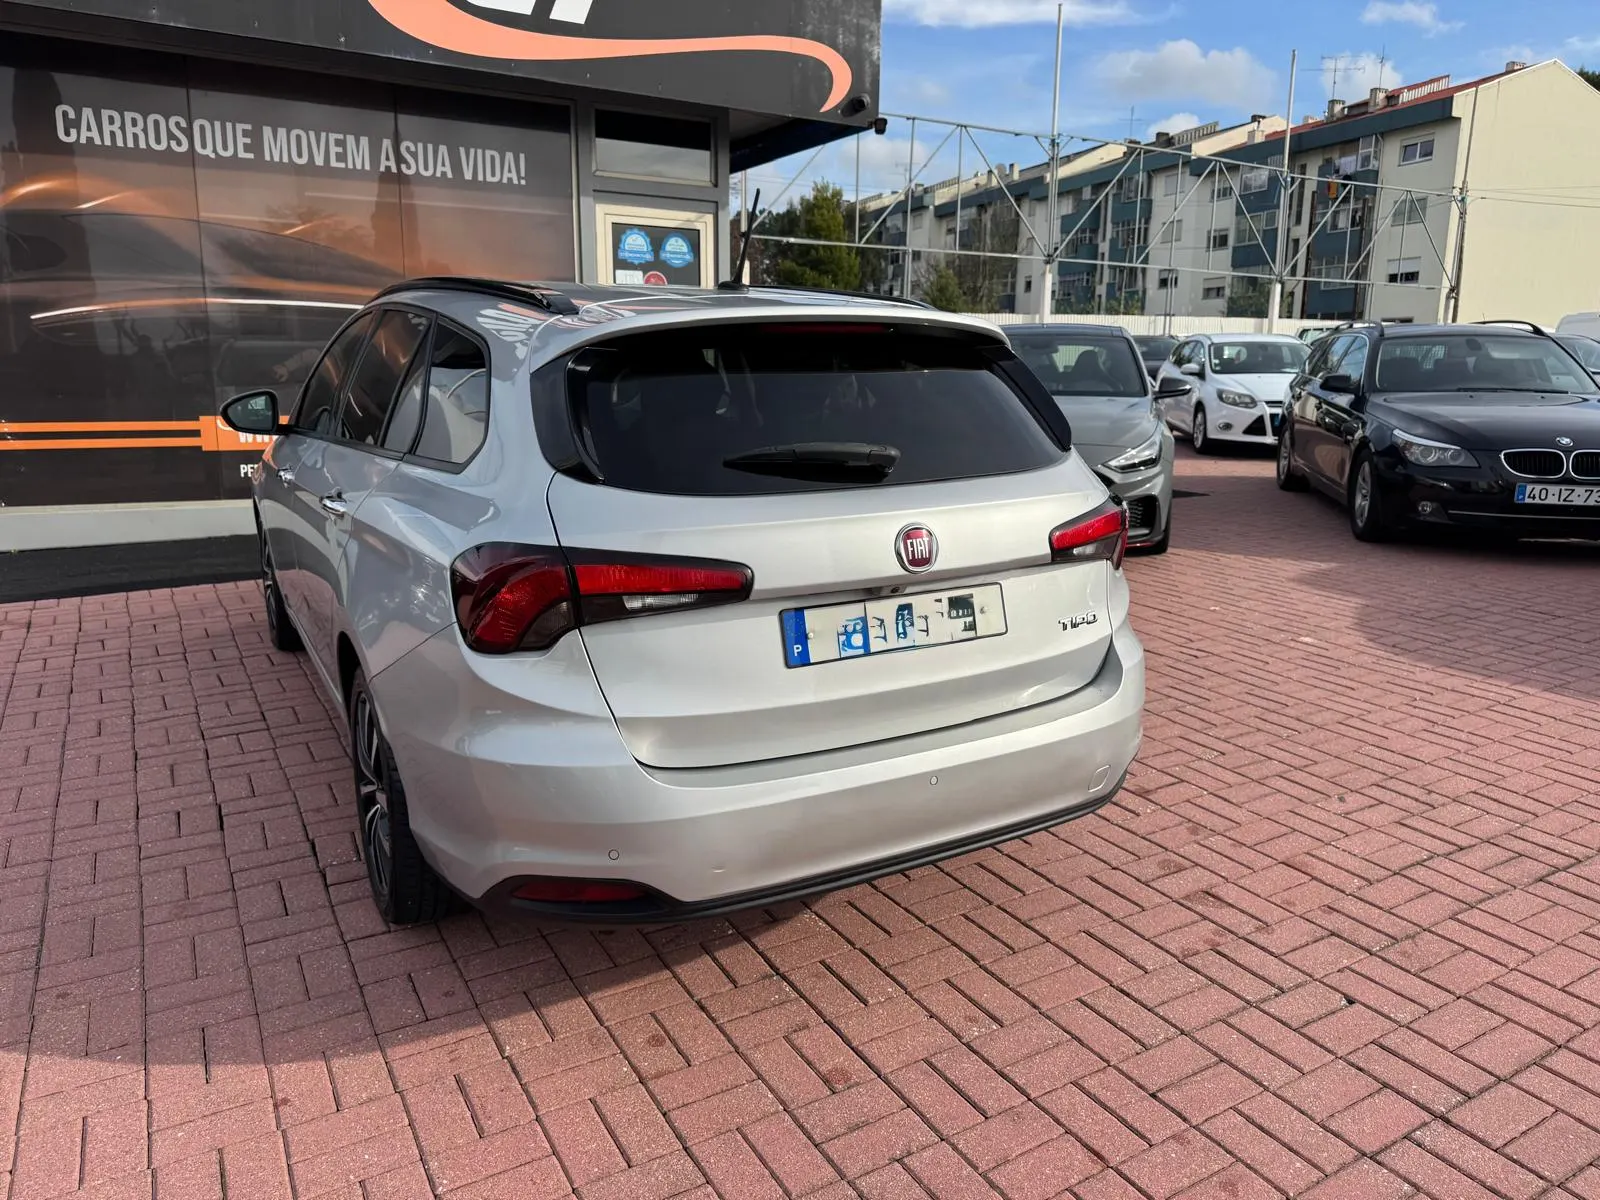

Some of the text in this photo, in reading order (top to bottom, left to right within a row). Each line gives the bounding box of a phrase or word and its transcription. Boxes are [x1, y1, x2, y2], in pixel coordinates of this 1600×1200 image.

[55, 104, 527, 186] CARROS QUE MOVEM A SUA VIDA!
[906, 537, 929, 560] FIAT
[1058, 611, 1098, 631] TIPO
[793, 645, 803, 657] P
